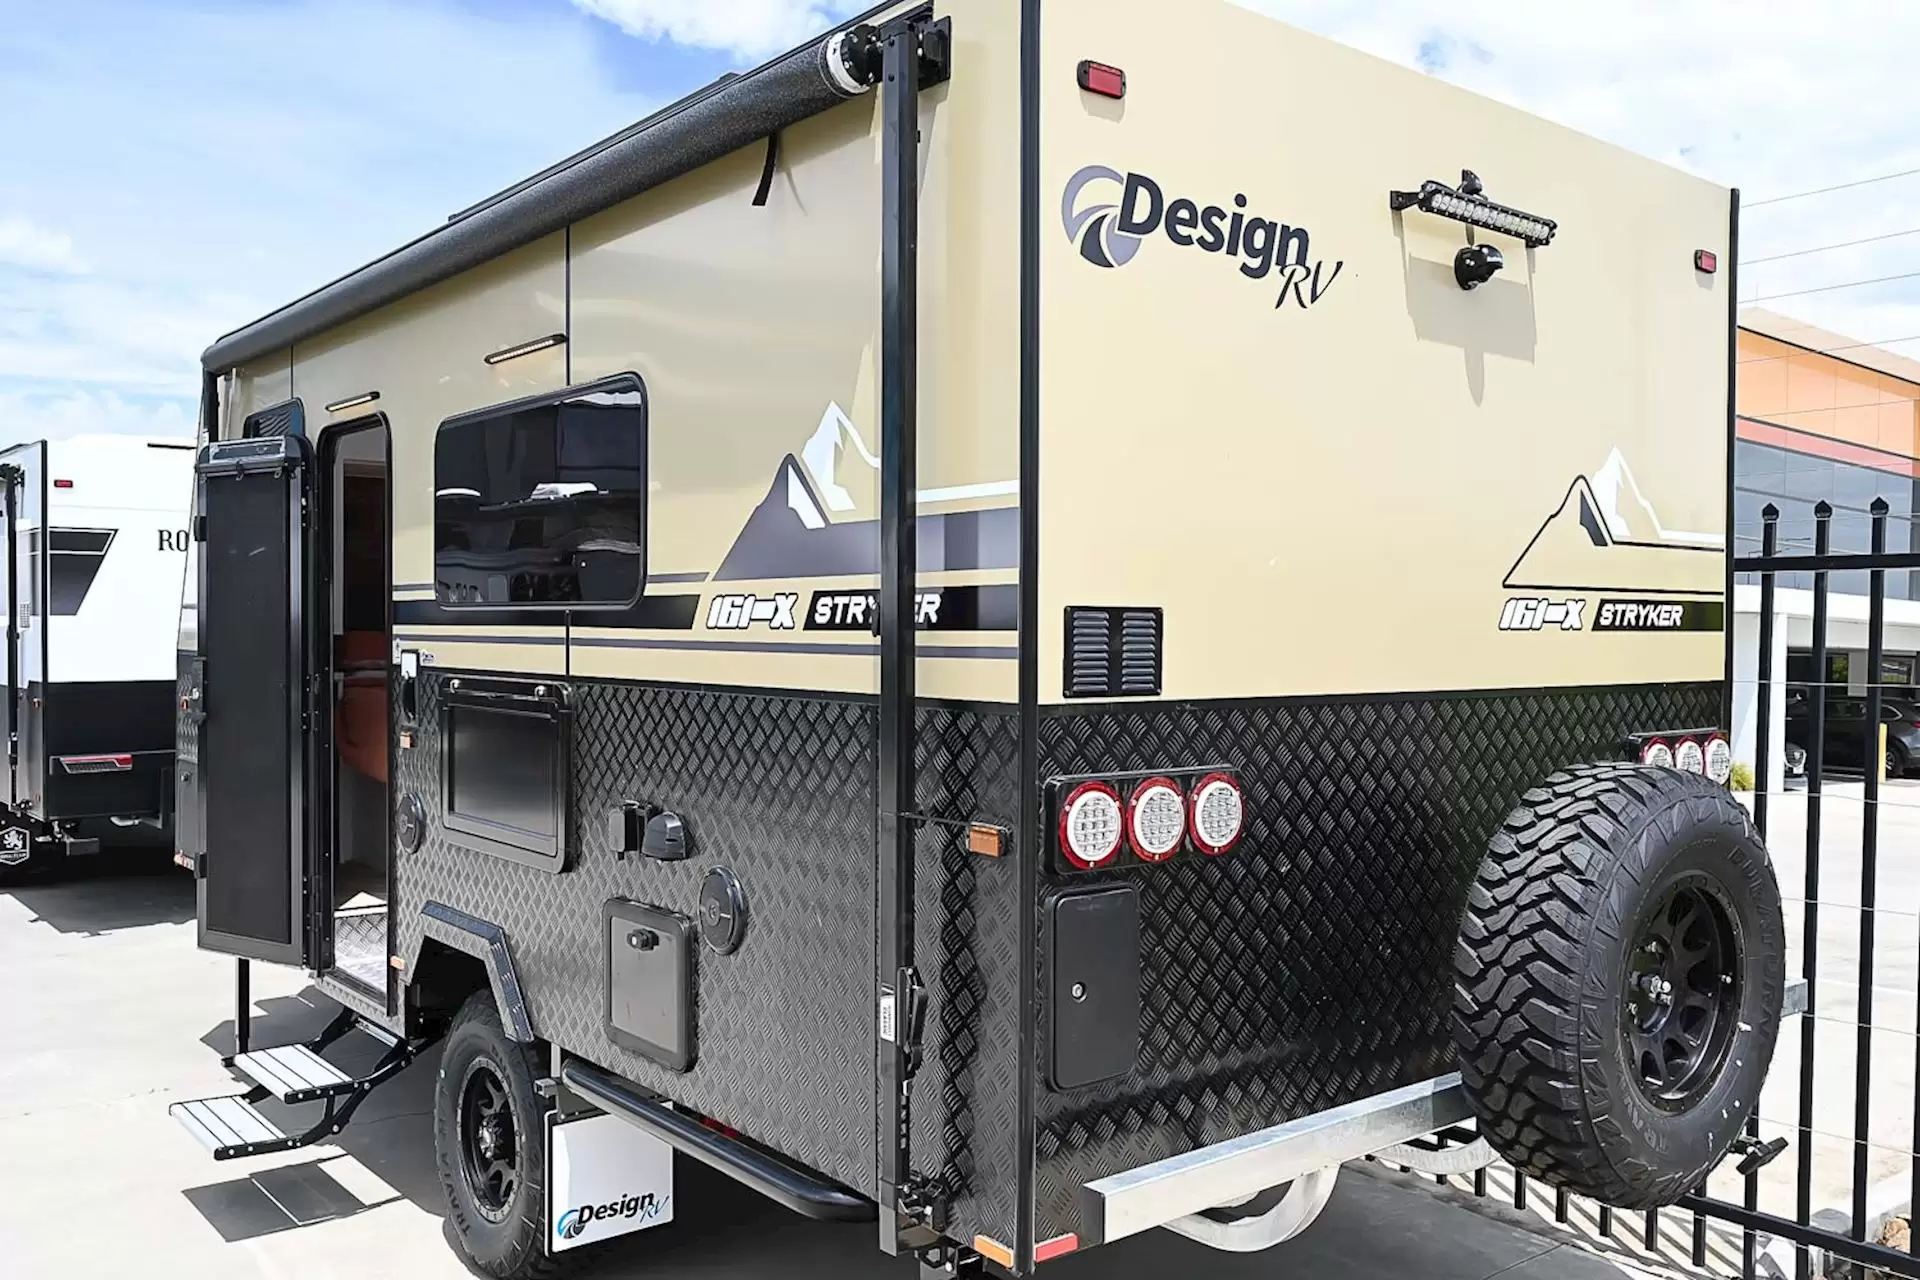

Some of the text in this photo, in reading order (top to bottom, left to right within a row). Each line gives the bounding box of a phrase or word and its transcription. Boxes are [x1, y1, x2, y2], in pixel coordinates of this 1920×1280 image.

[1117, 172, 1310, 279] Design
[1275, 261, 1343, 309] RV
[814, 593, 942, 625] STRYR
[1601, 603, 1684, 627] STRYKER
[577, 1192, 656, 1226] Design
[640, 1195, 671, 1223] RV
